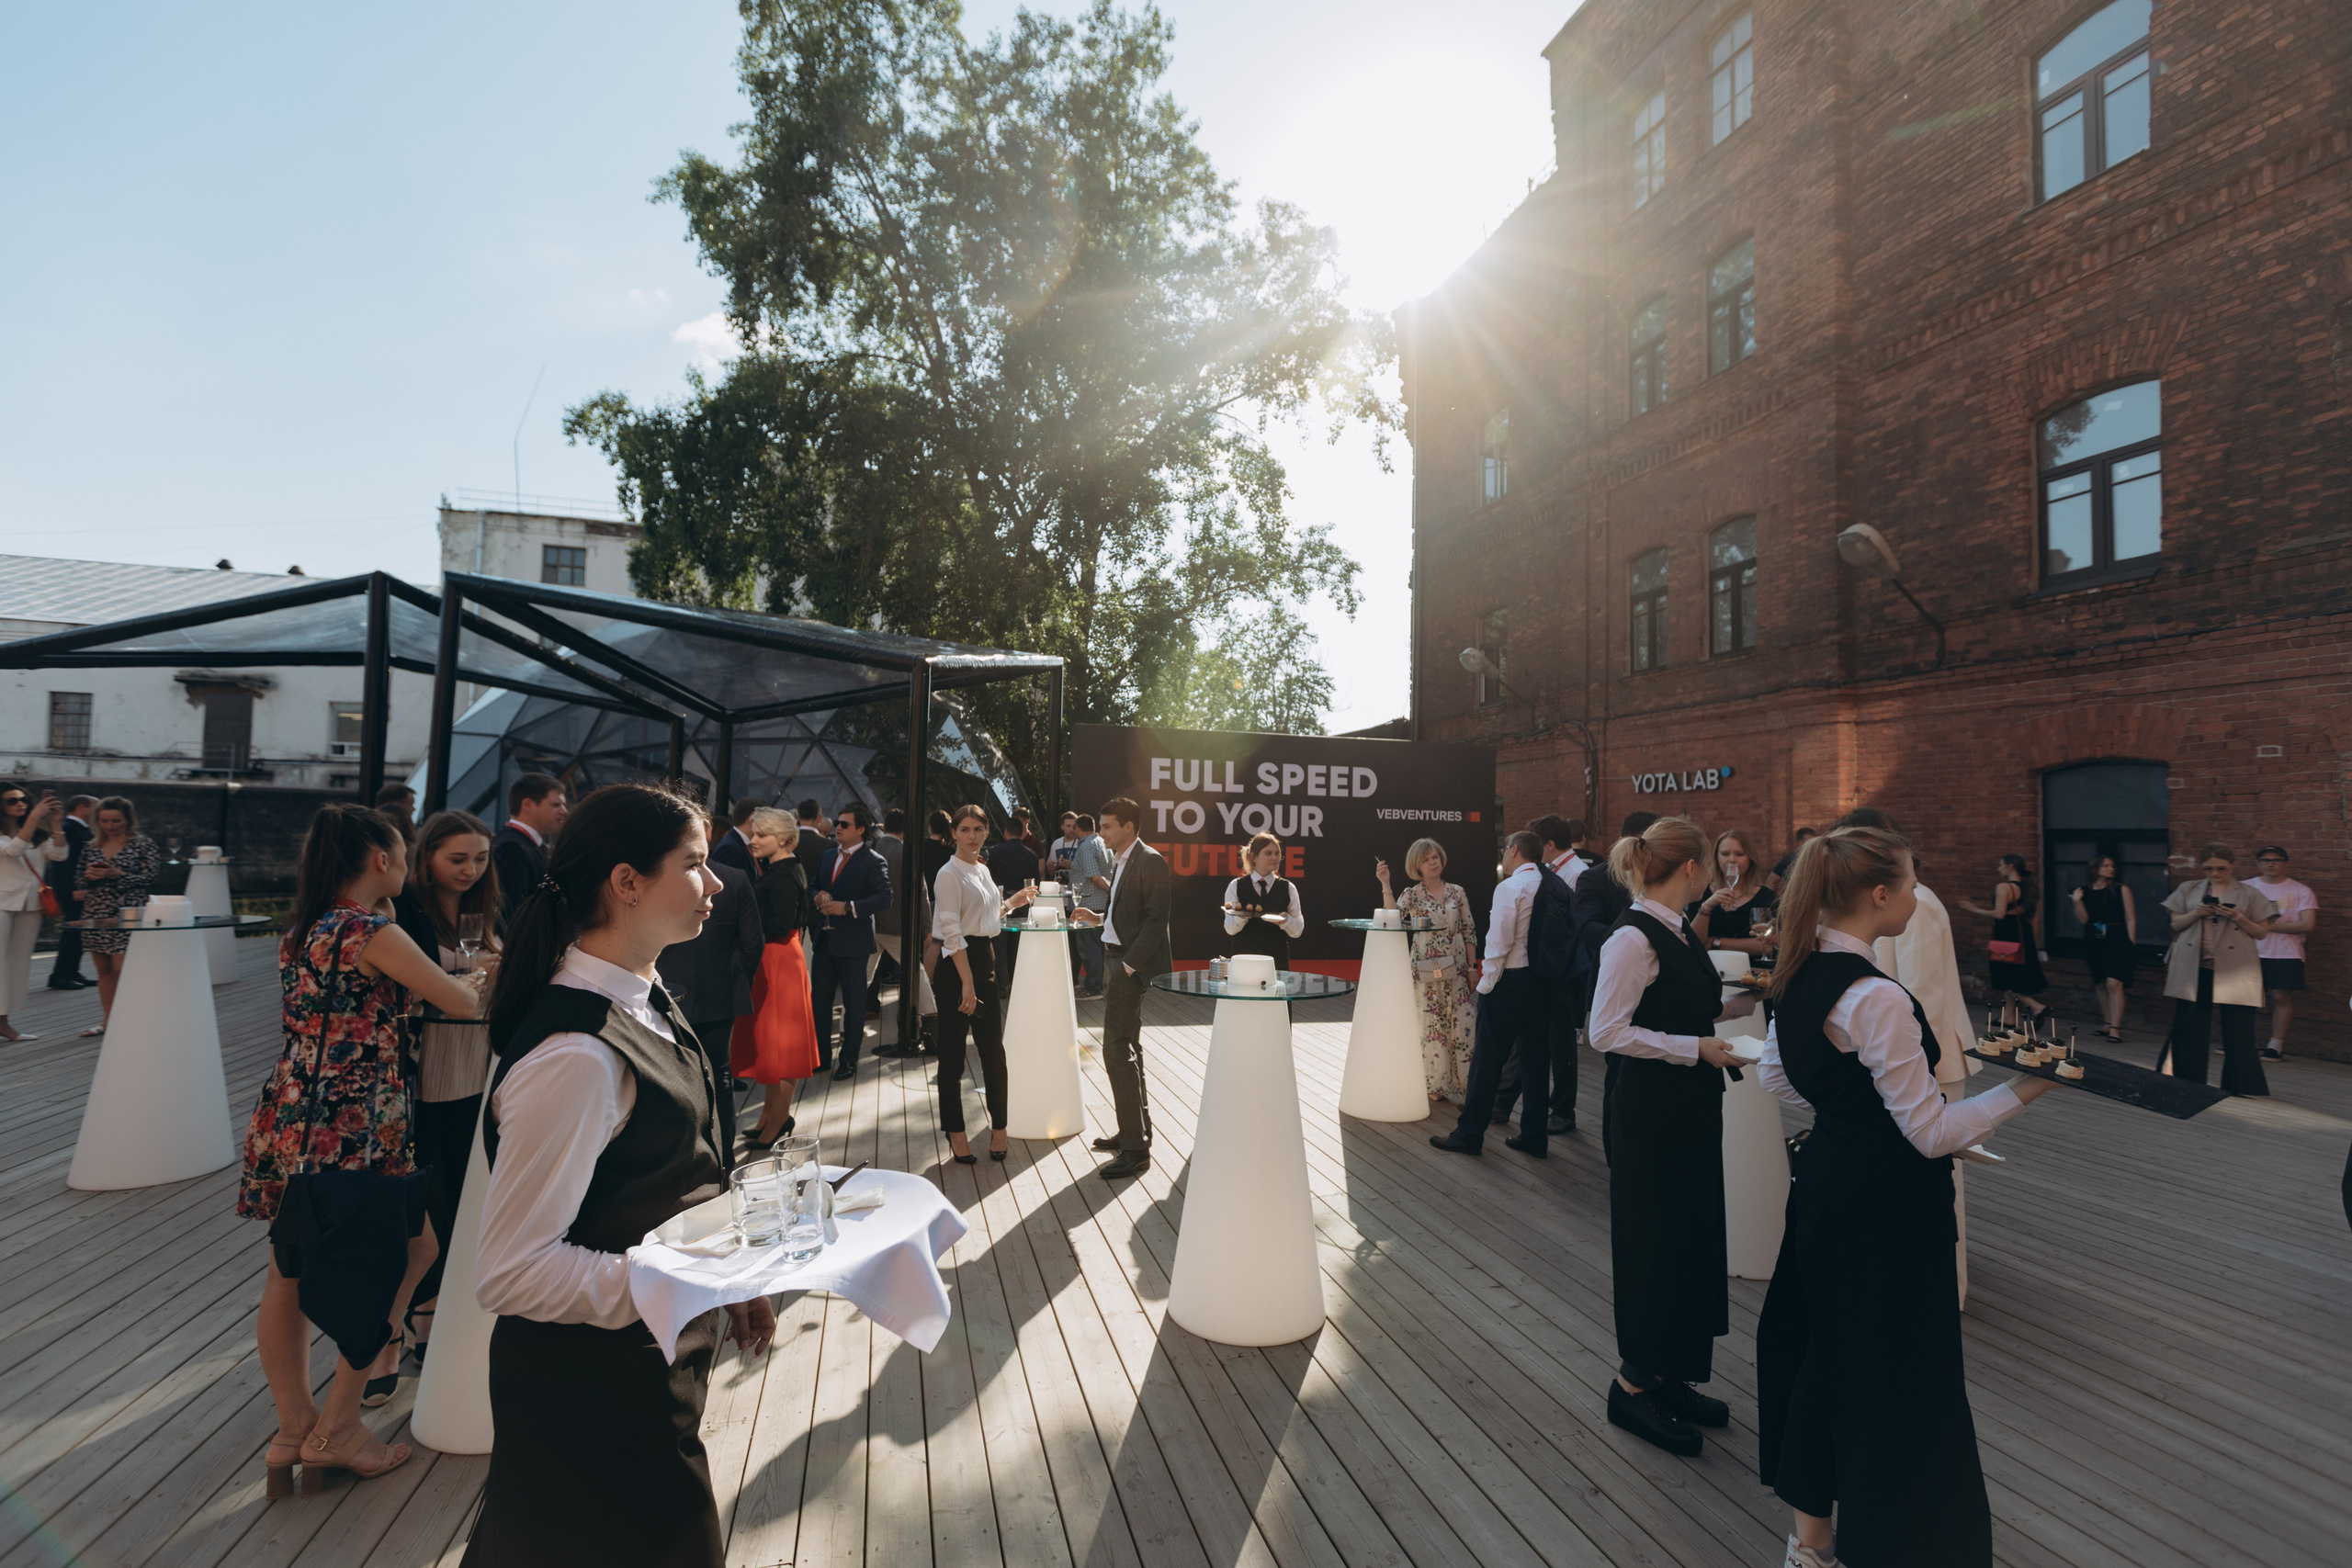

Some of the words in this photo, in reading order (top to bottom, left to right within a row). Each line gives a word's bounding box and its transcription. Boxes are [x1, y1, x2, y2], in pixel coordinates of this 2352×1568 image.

[1150, 757, 1244, 794] FULL
[1256, 761, 1378, 798] SPEED
[1631, 772, 1678, 794] YOTA
[1682, 768, 1720, 791] LAB
[1150, 799, 1206, 834] TO
[1216, 802, 1324, 838] YOUR
[1376, 808, 1463, 822] VEBVENTURES
[1148, 842, 1306, 878] UTUE
